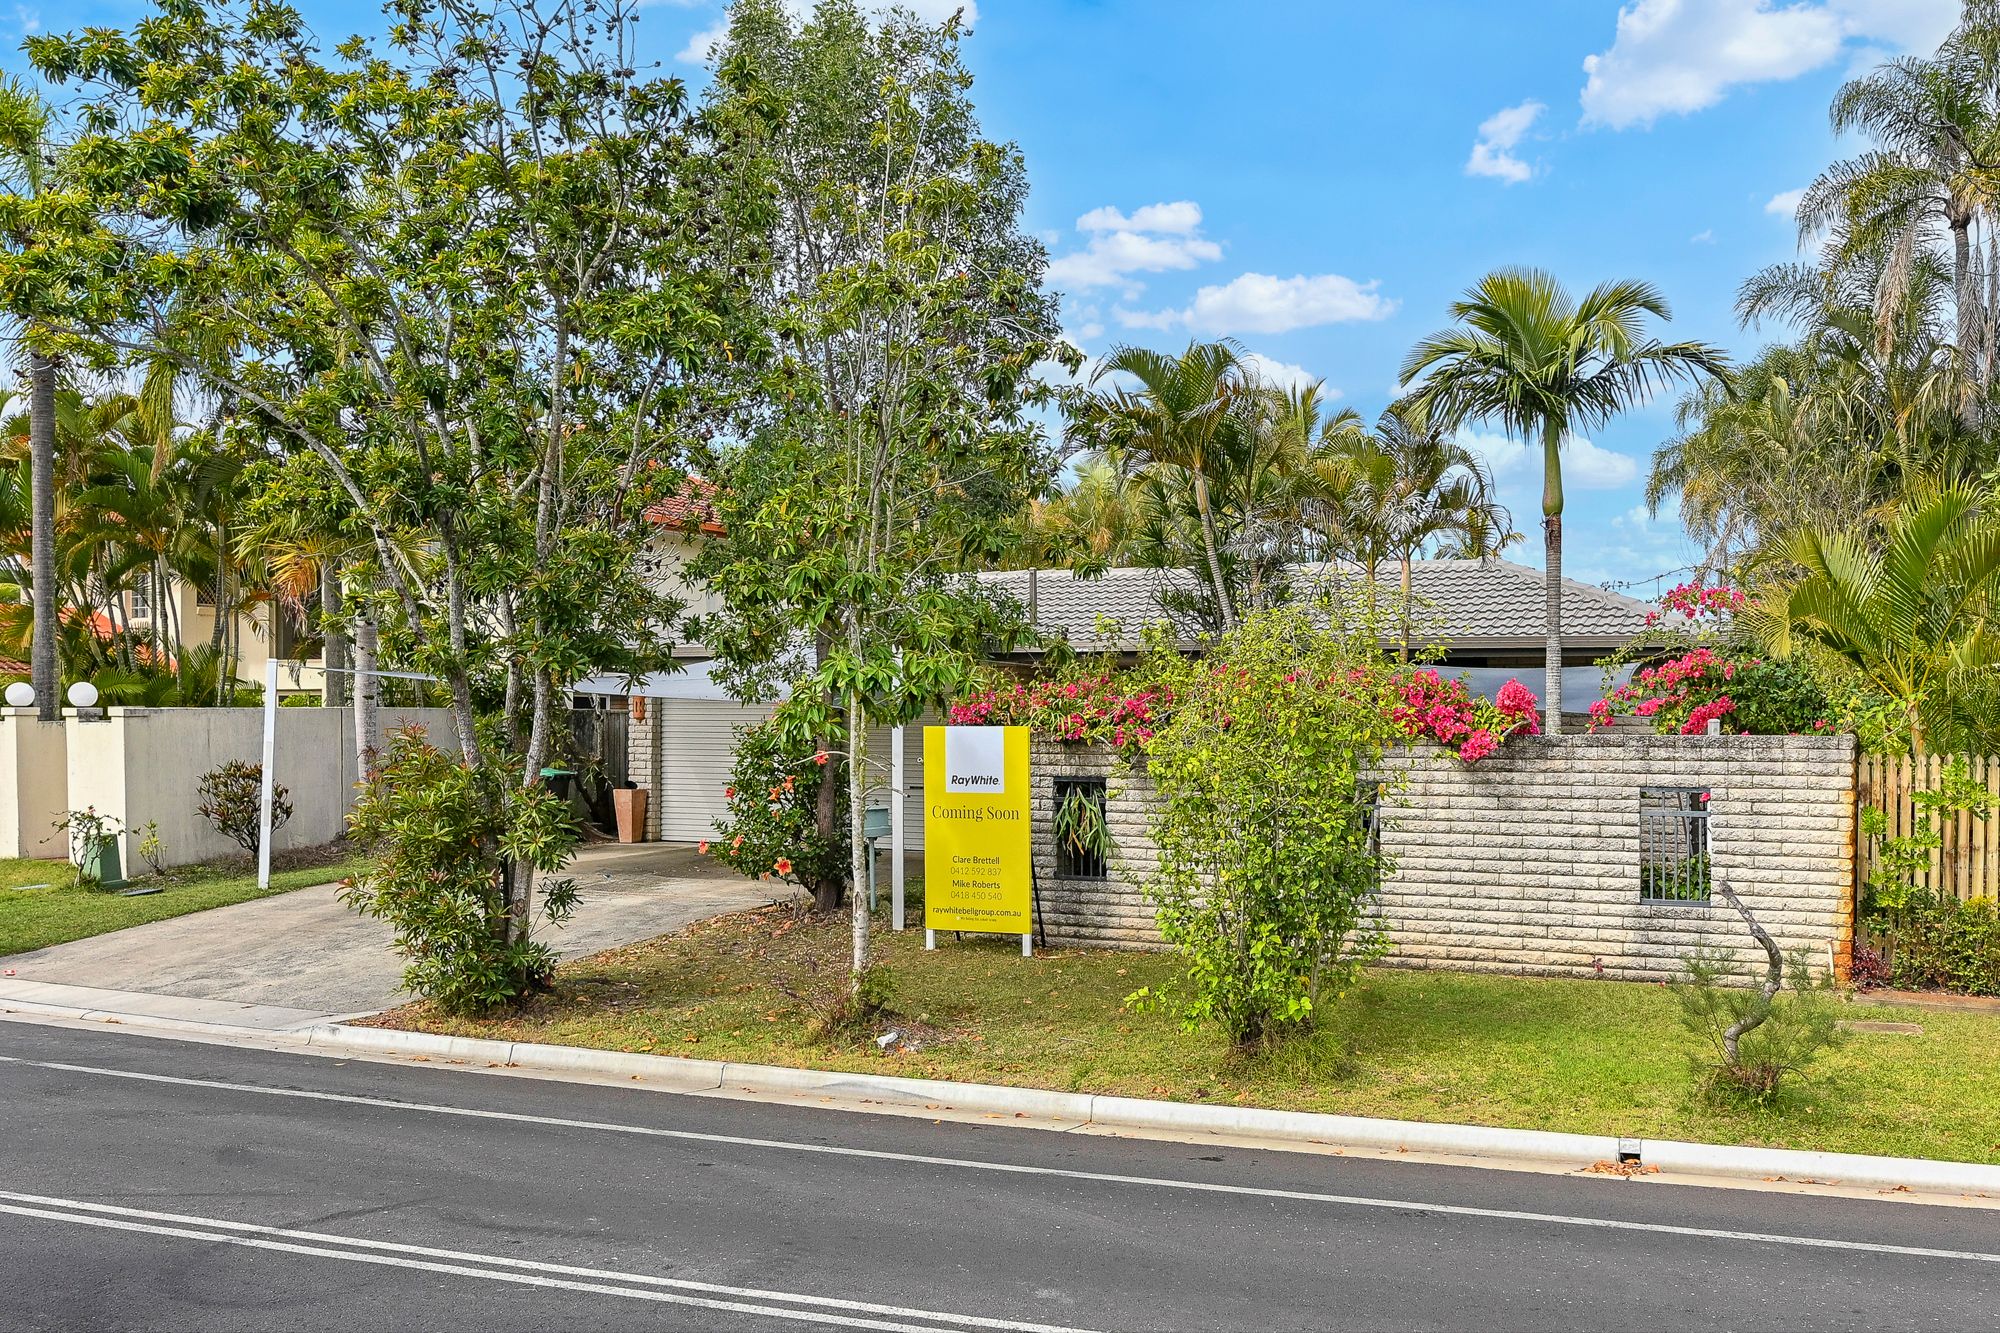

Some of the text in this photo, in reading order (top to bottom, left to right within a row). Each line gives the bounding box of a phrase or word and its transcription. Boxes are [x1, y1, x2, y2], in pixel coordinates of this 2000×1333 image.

[932, 805, 1019, 822] Coming Soon
[952, 855, 1000, 865] Clare Brettell
[950, 867, 1002, 876] 0412 592 837
[952, 880, 1001, 889] Mike Roberts
[950, 890, 1003, 901] 0418 450 540
[932, 906, 1022, 917] raywhitebellgroup.com.au
